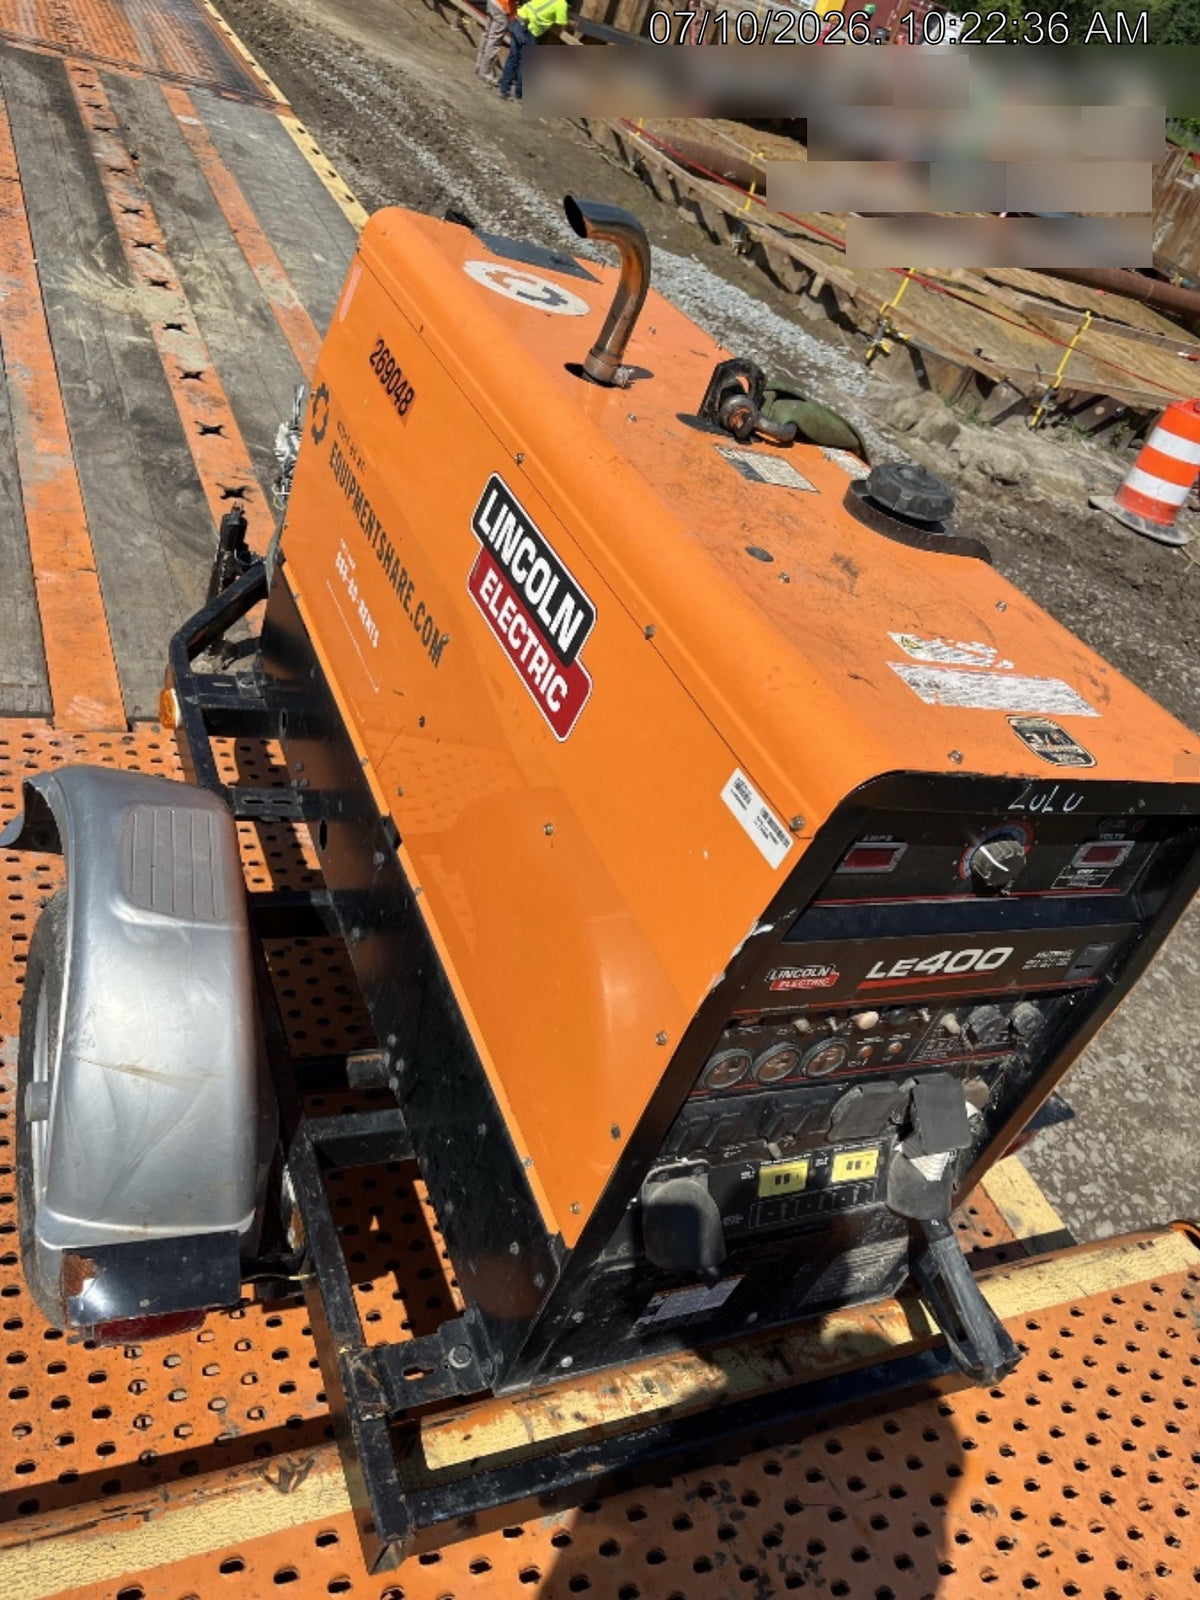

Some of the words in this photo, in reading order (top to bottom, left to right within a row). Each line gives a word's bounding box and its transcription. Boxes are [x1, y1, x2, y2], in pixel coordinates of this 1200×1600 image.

[368, 338, 416, 418] 269048
[329, 441, 447, 669] EQUIPMENTSHARE.COM
[478, 489, 585, 655] LINCOLN
[480, 569, 570, 713] ELECTRIC
[769, 966, 831, 980] LINCOLN
[865, 946, 1014, 979] LE400
